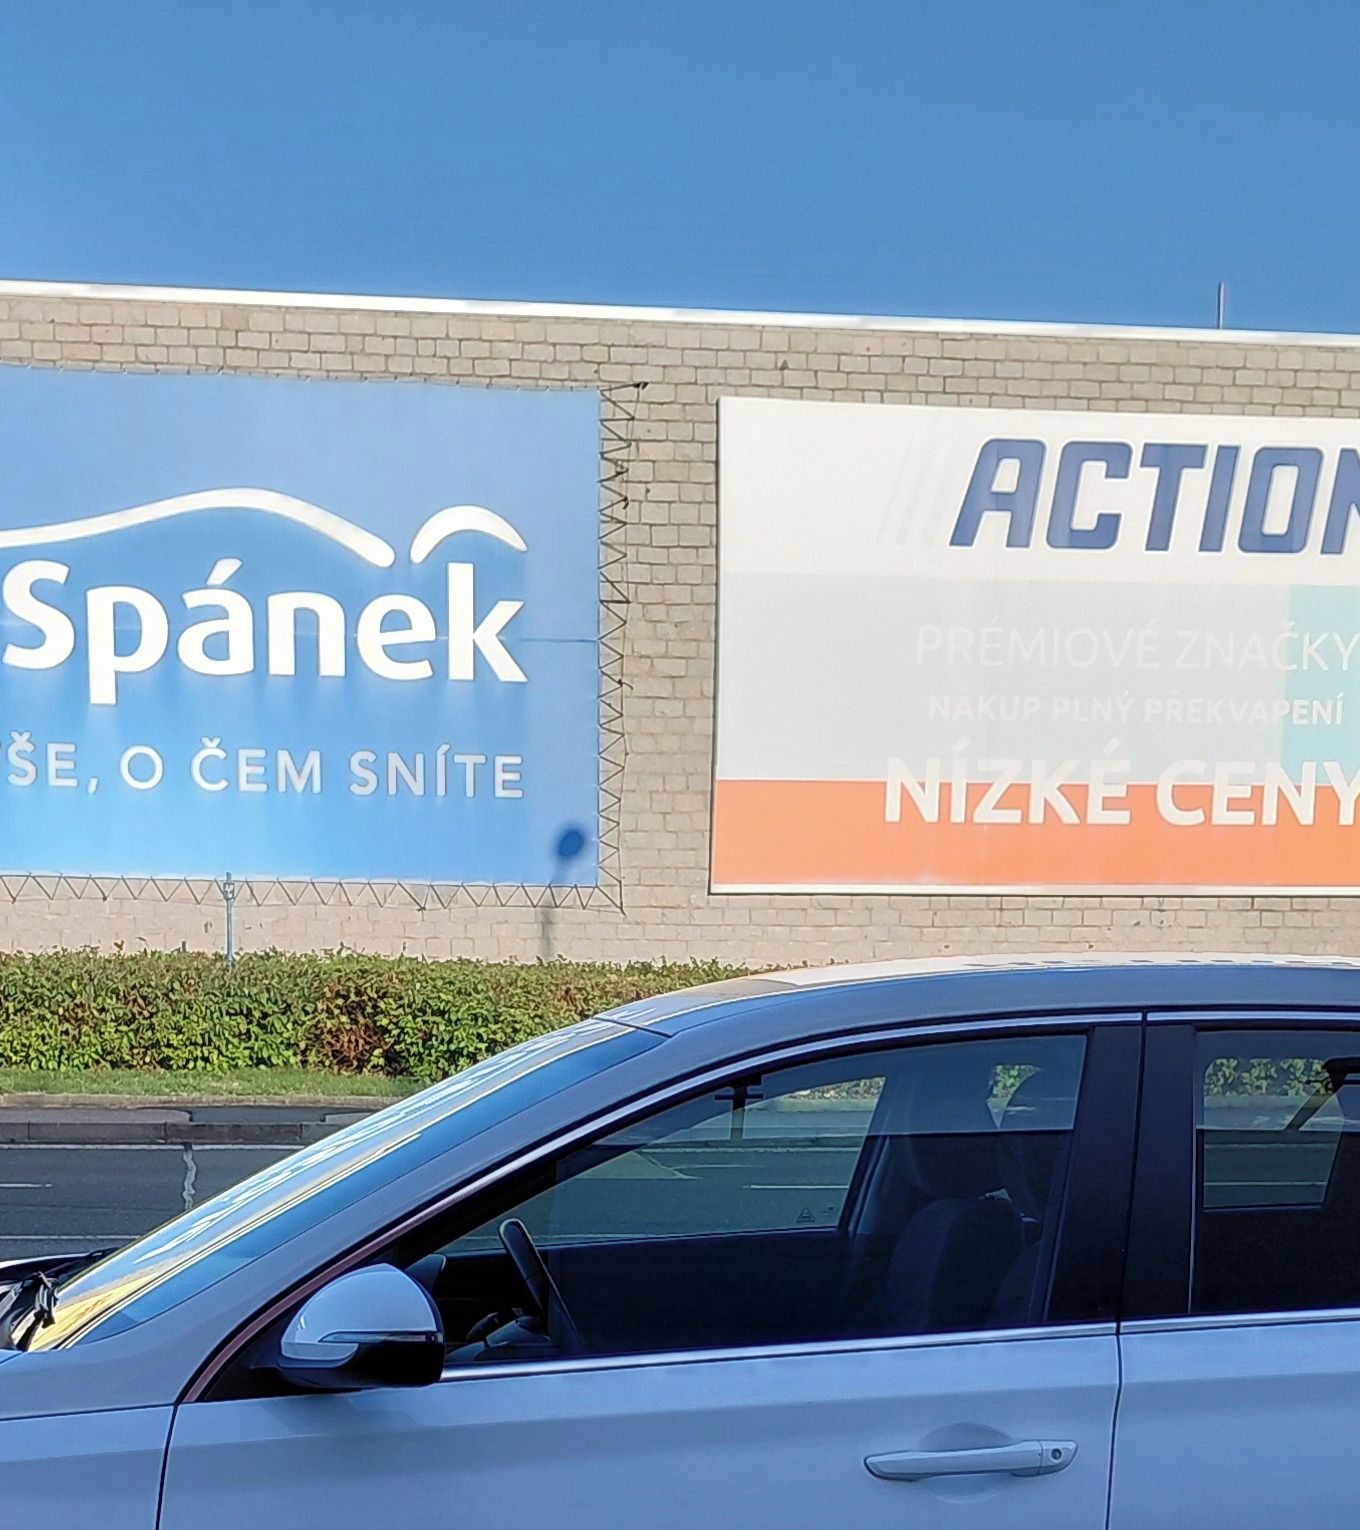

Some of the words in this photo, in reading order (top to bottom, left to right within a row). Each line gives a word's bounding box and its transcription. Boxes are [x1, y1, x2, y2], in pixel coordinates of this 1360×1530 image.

[915, 615, 1160, 671] PRÉMIOVÉ
[927, 686, 1041, 722] NÁKUP
[1050, 689, 1137, 723] PLNÝ
[1143, 691, 1344, 725] PŘEKVAPENÍ
[120, 745, 165, 791] O
[191, 737, 322, 795] ČEM
[349, 744, 525, 800] SNÍTE
[883, 735, 1132, 824] NÍZKÉ
